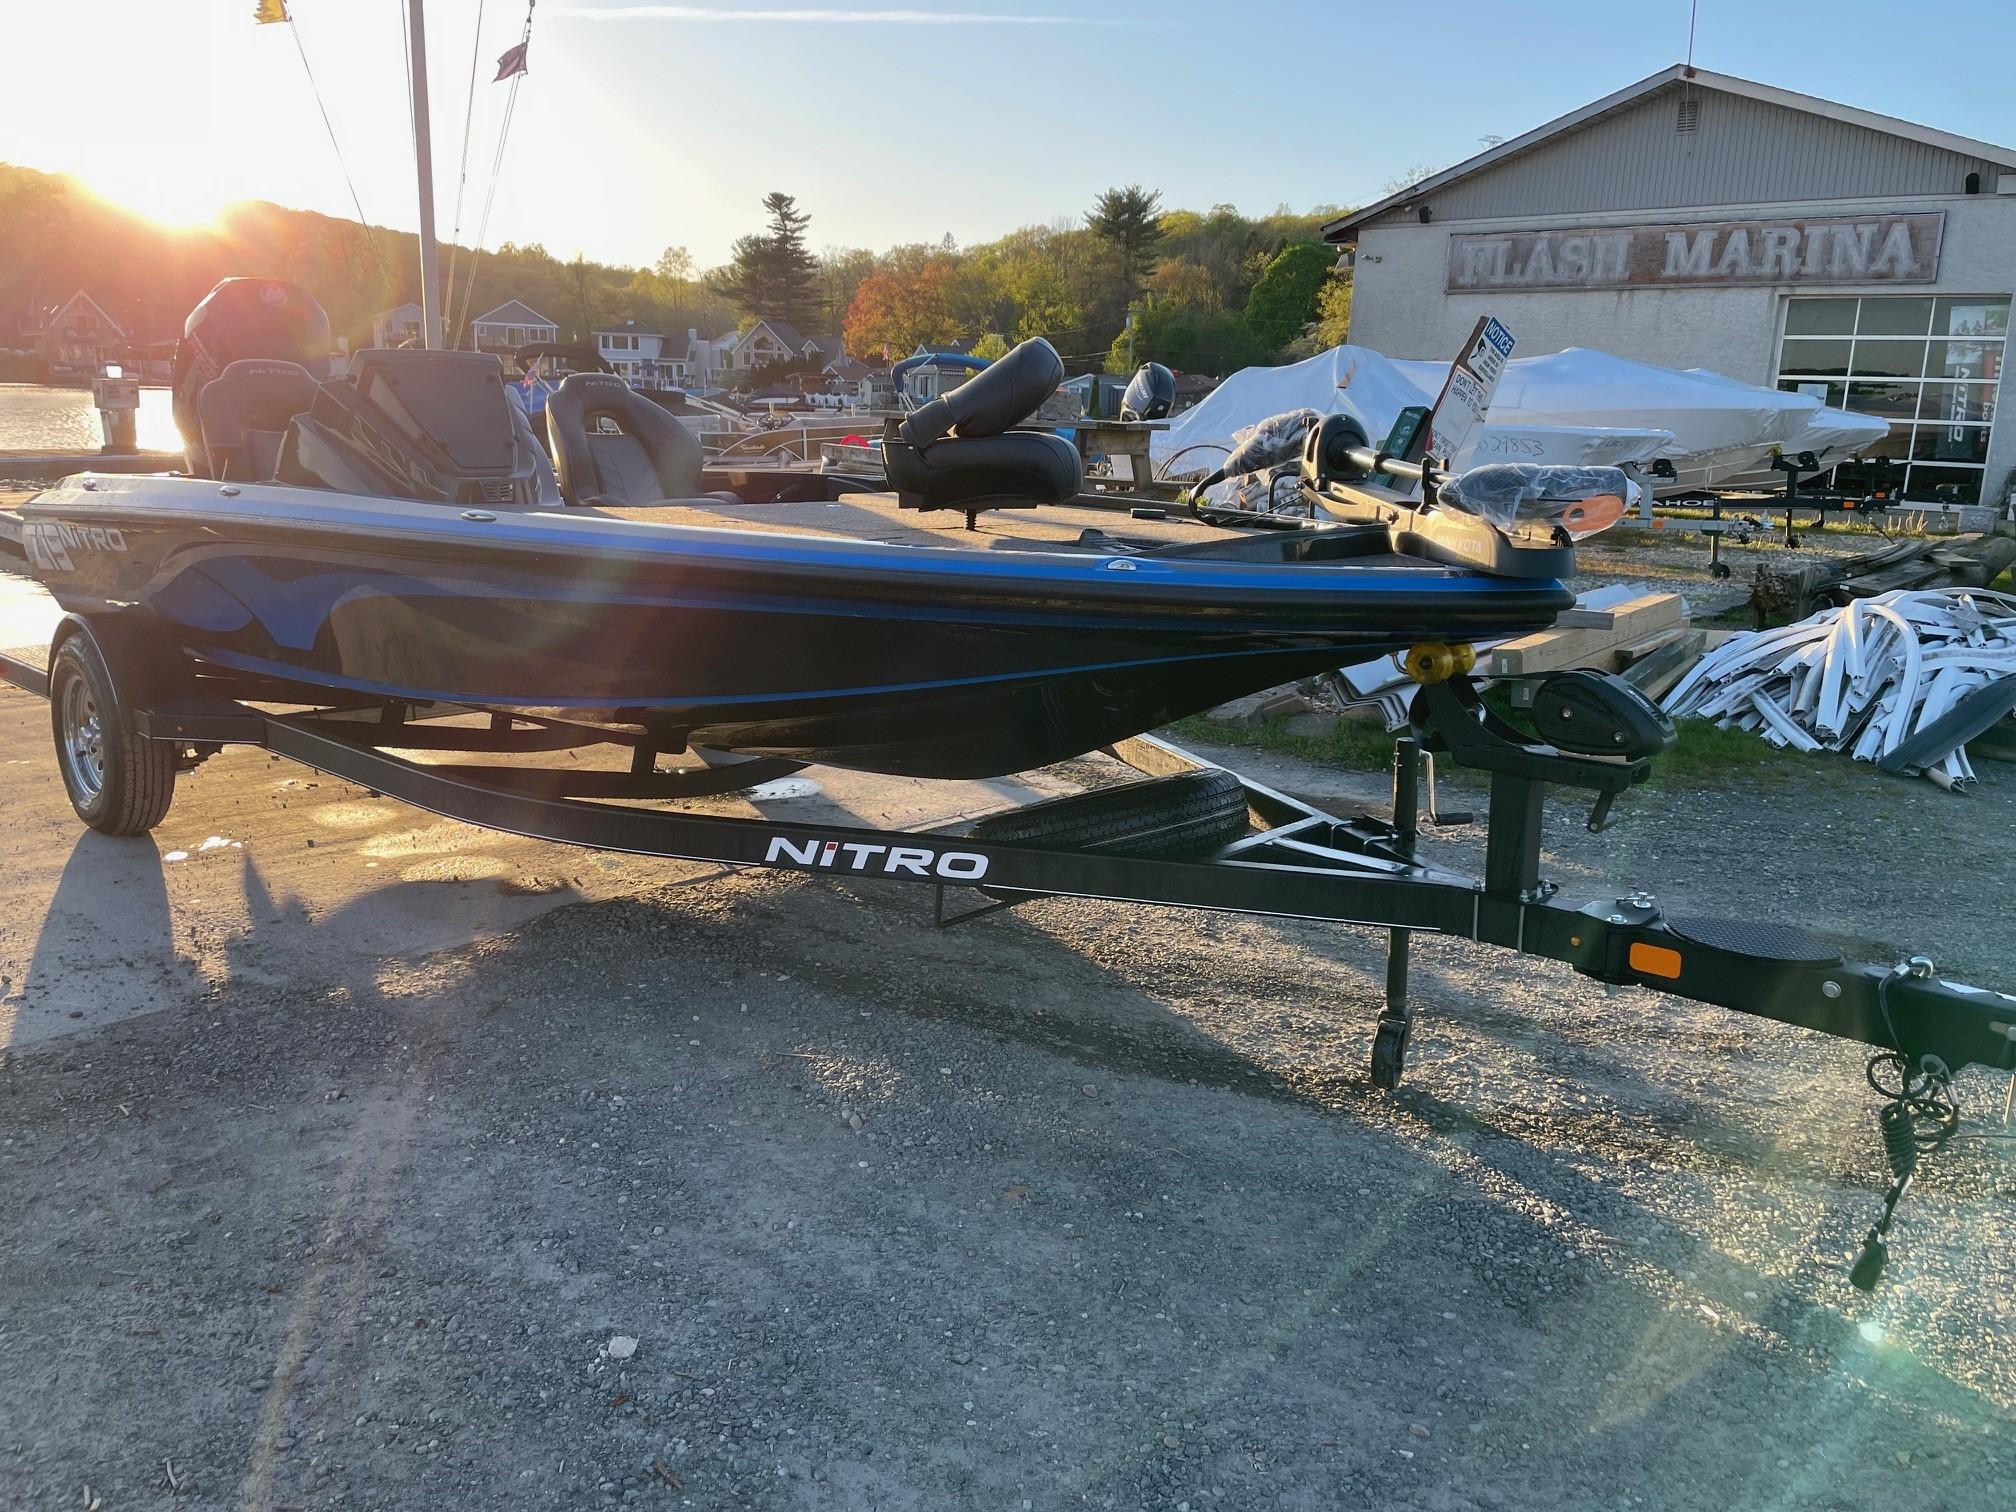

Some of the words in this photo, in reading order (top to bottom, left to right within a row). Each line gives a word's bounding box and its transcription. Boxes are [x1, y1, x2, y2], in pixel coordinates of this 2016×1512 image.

[1457, 232, 1635, 286] FLASH
[1661, 222, 1922, 279] MARINA
[1486, 320, 1513, 354] NOTICE
[1980, 401, 1992, 443] bots
[1651, 499, 1715, 507] AHOE
